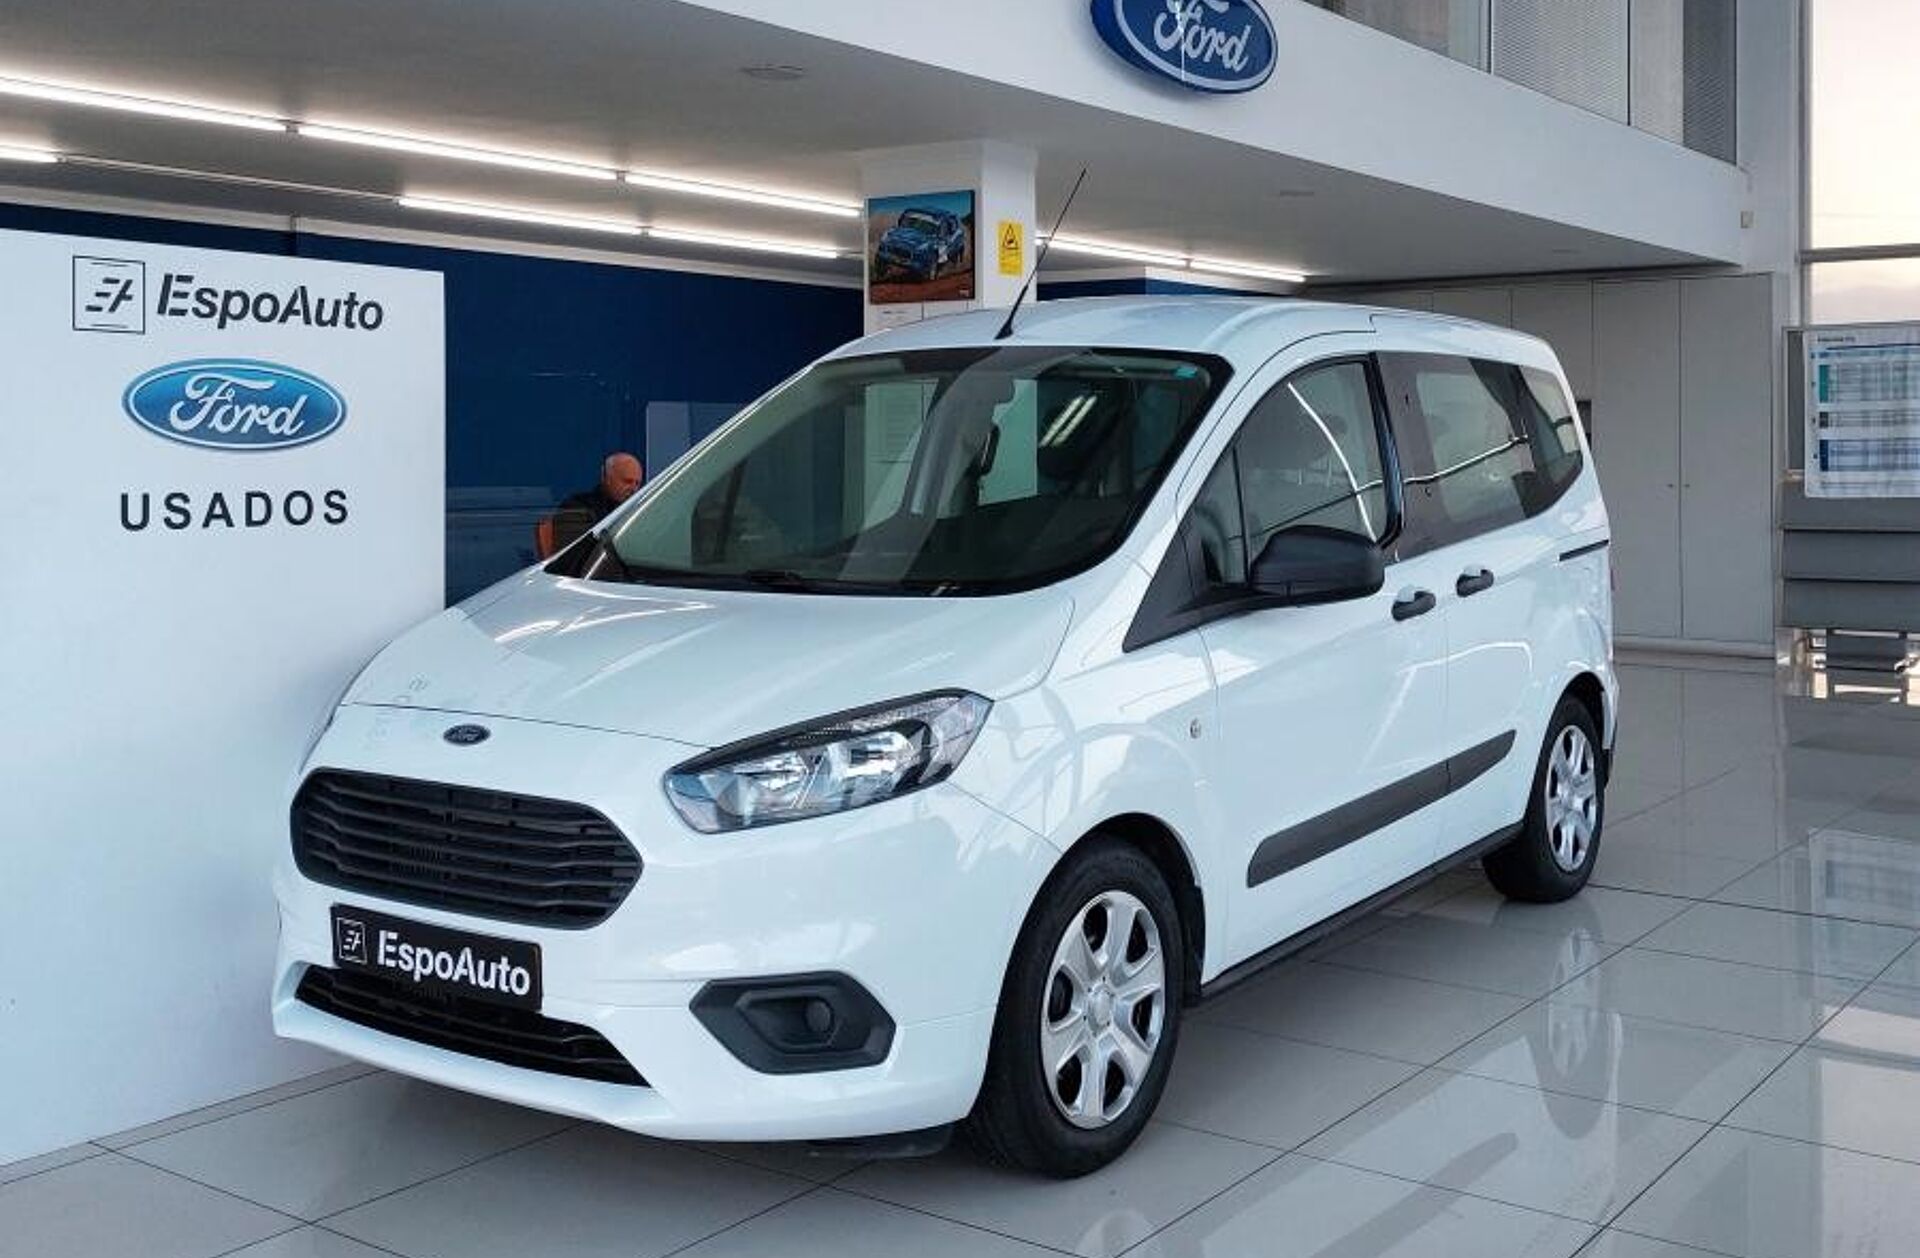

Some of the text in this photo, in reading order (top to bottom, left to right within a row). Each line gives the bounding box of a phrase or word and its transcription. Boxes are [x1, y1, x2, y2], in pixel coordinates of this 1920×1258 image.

[156, 272, 384, 331] EspoAuto
[168, 371, 305, 437] Ford
[120, 489, 349, 532] USADOS
[376, 929, 531, 996] EspoAuto
